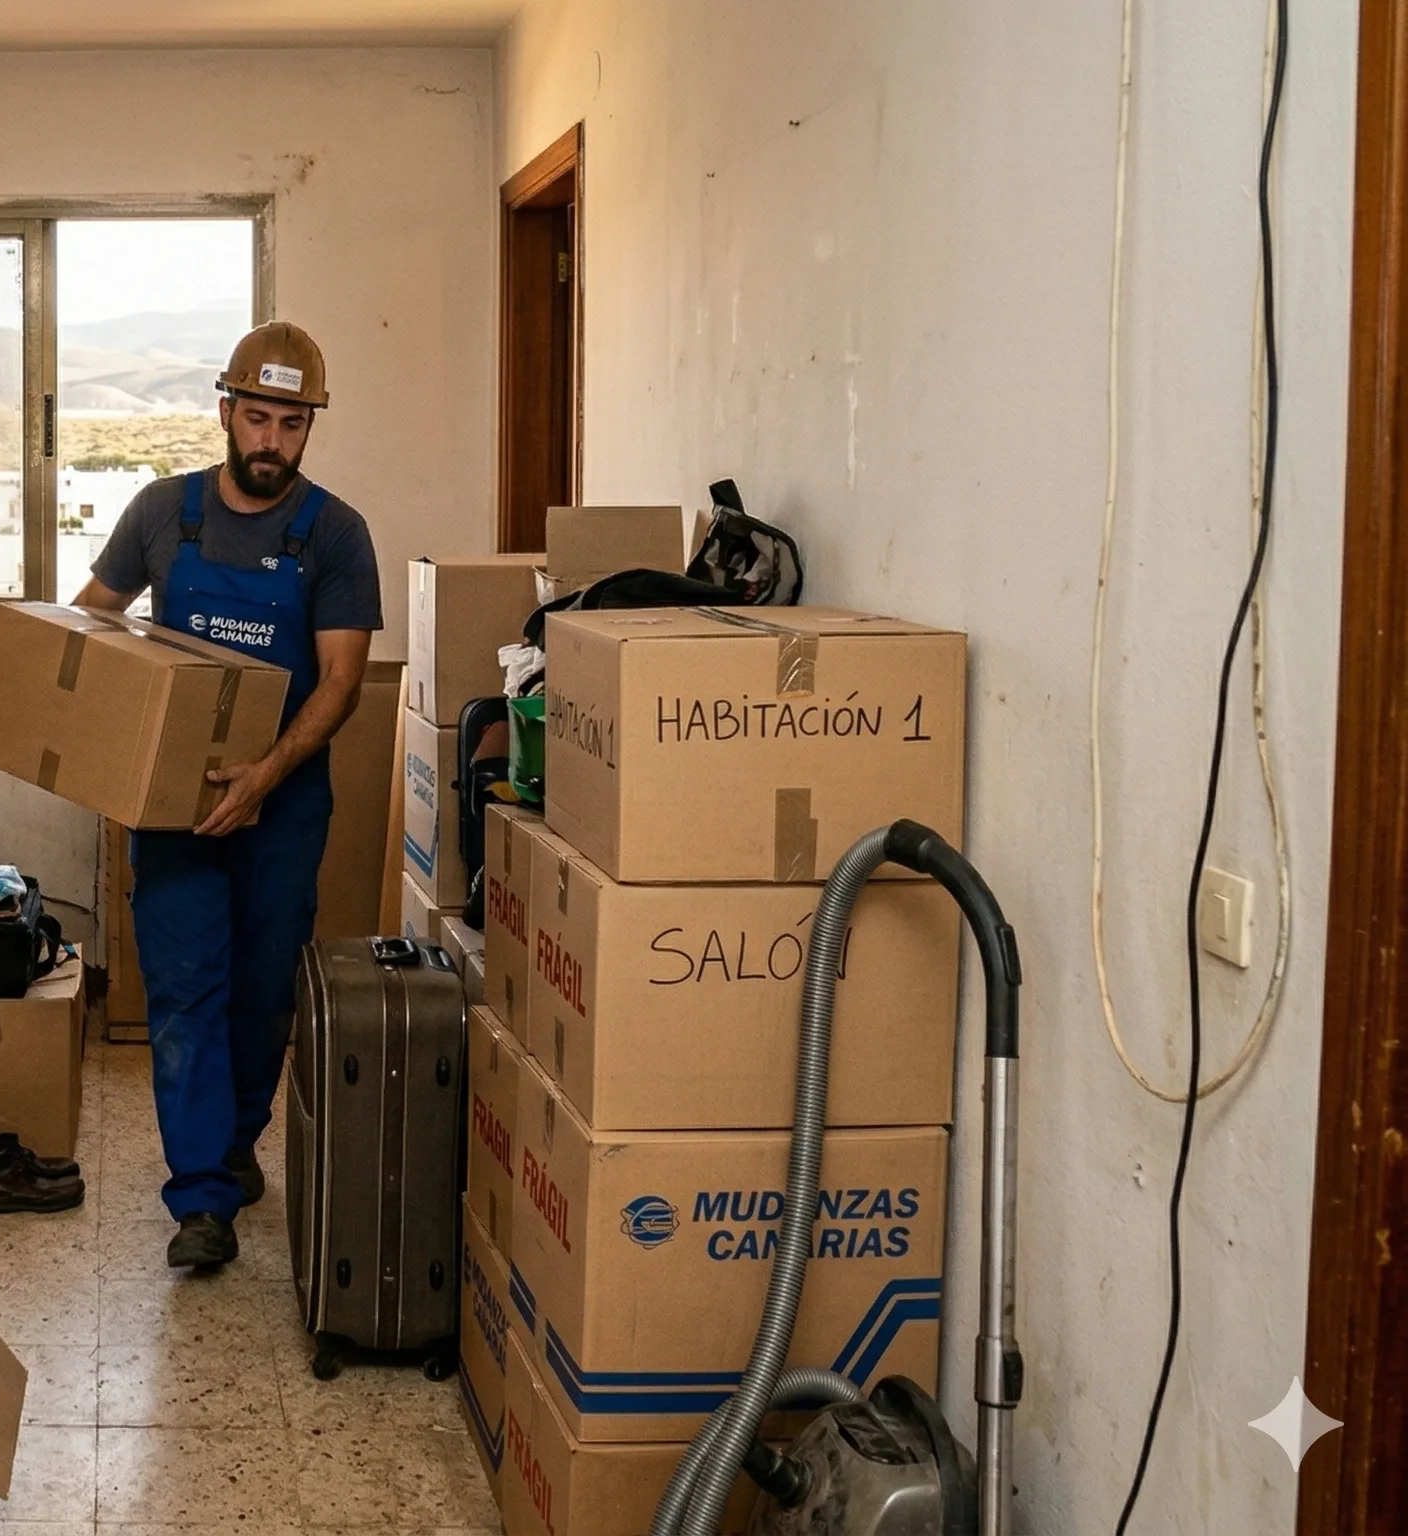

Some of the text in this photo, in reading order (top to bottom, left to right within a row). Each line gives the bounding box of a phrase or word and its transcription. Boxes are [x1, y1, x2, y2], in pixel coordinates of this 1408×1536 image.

[210, 616, 275, 635] MUDANZAS
[903, 695, 931, 741] 1
[489, 875, 528, 947] FRÁGIL
[537, 927, 586, 1018] FRÁGIL
[473, 1091, 514, 1180] FRÁGIL
[523, 1144, 571, 1255] FRÁGIL
[692, 1188, 920, 1222] MUDNZAS
[707, 1226, 910, 1261] CANRIAS
